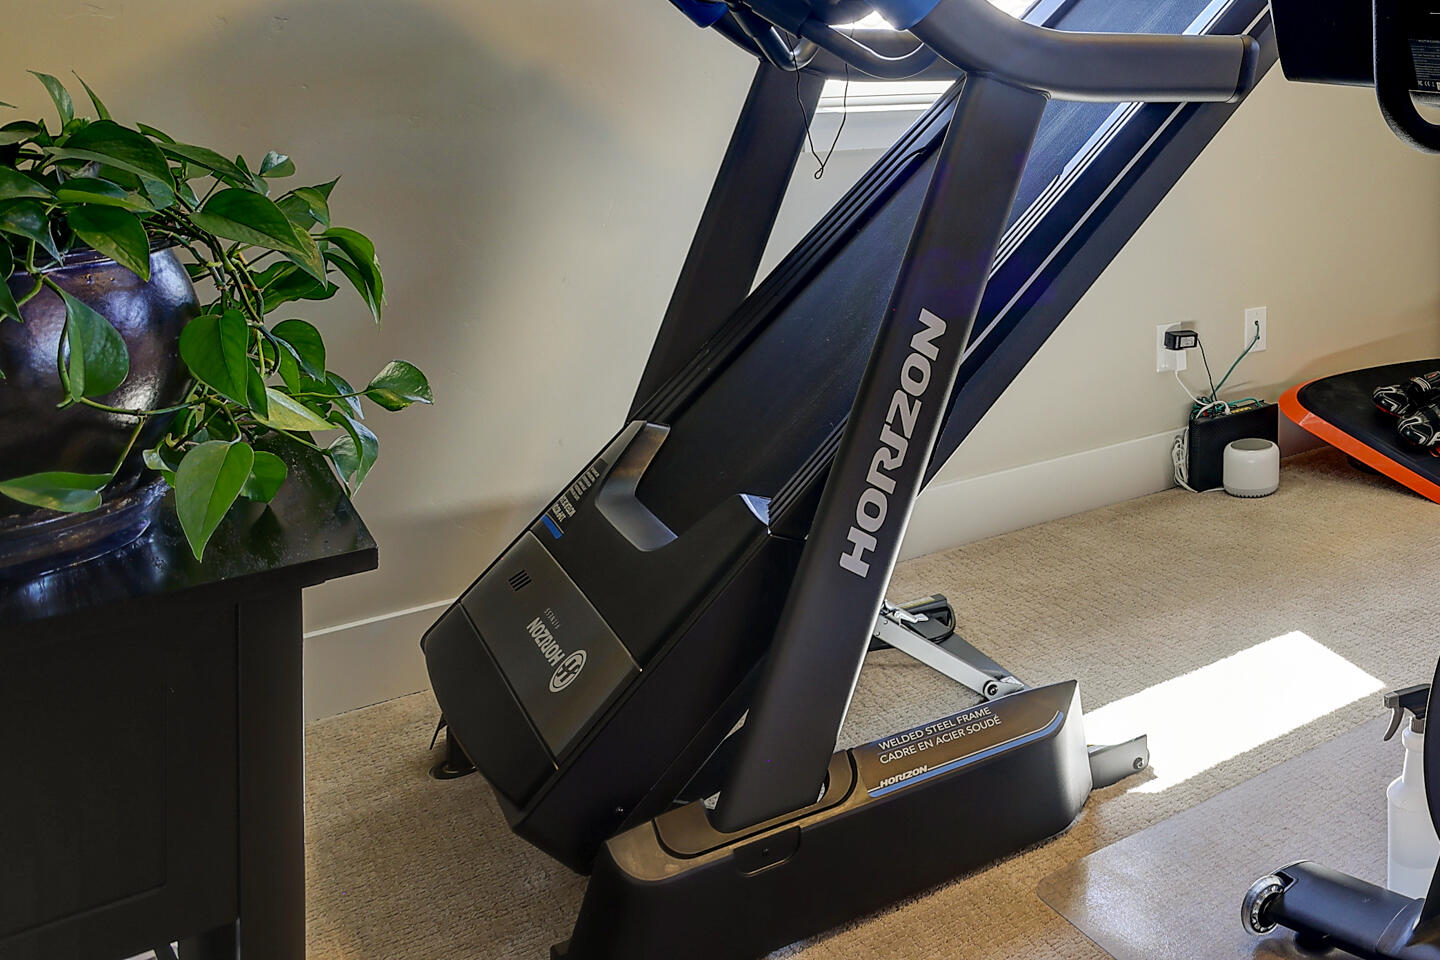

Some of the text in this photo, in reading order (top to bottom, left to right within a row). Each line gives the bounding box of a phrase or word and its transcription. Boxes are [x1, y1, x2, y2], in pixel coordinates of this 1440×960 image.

[840, 307, 947, 578] HORIZON
[526, 616, 566, 667] HORIZON
[878, 706, 992, 751] WELDED STEEL FRAME
[880, 714, 1002, 764] CADRE EN ACIER SOUDÉ
[880, 765, 928, 788] HORIZON
